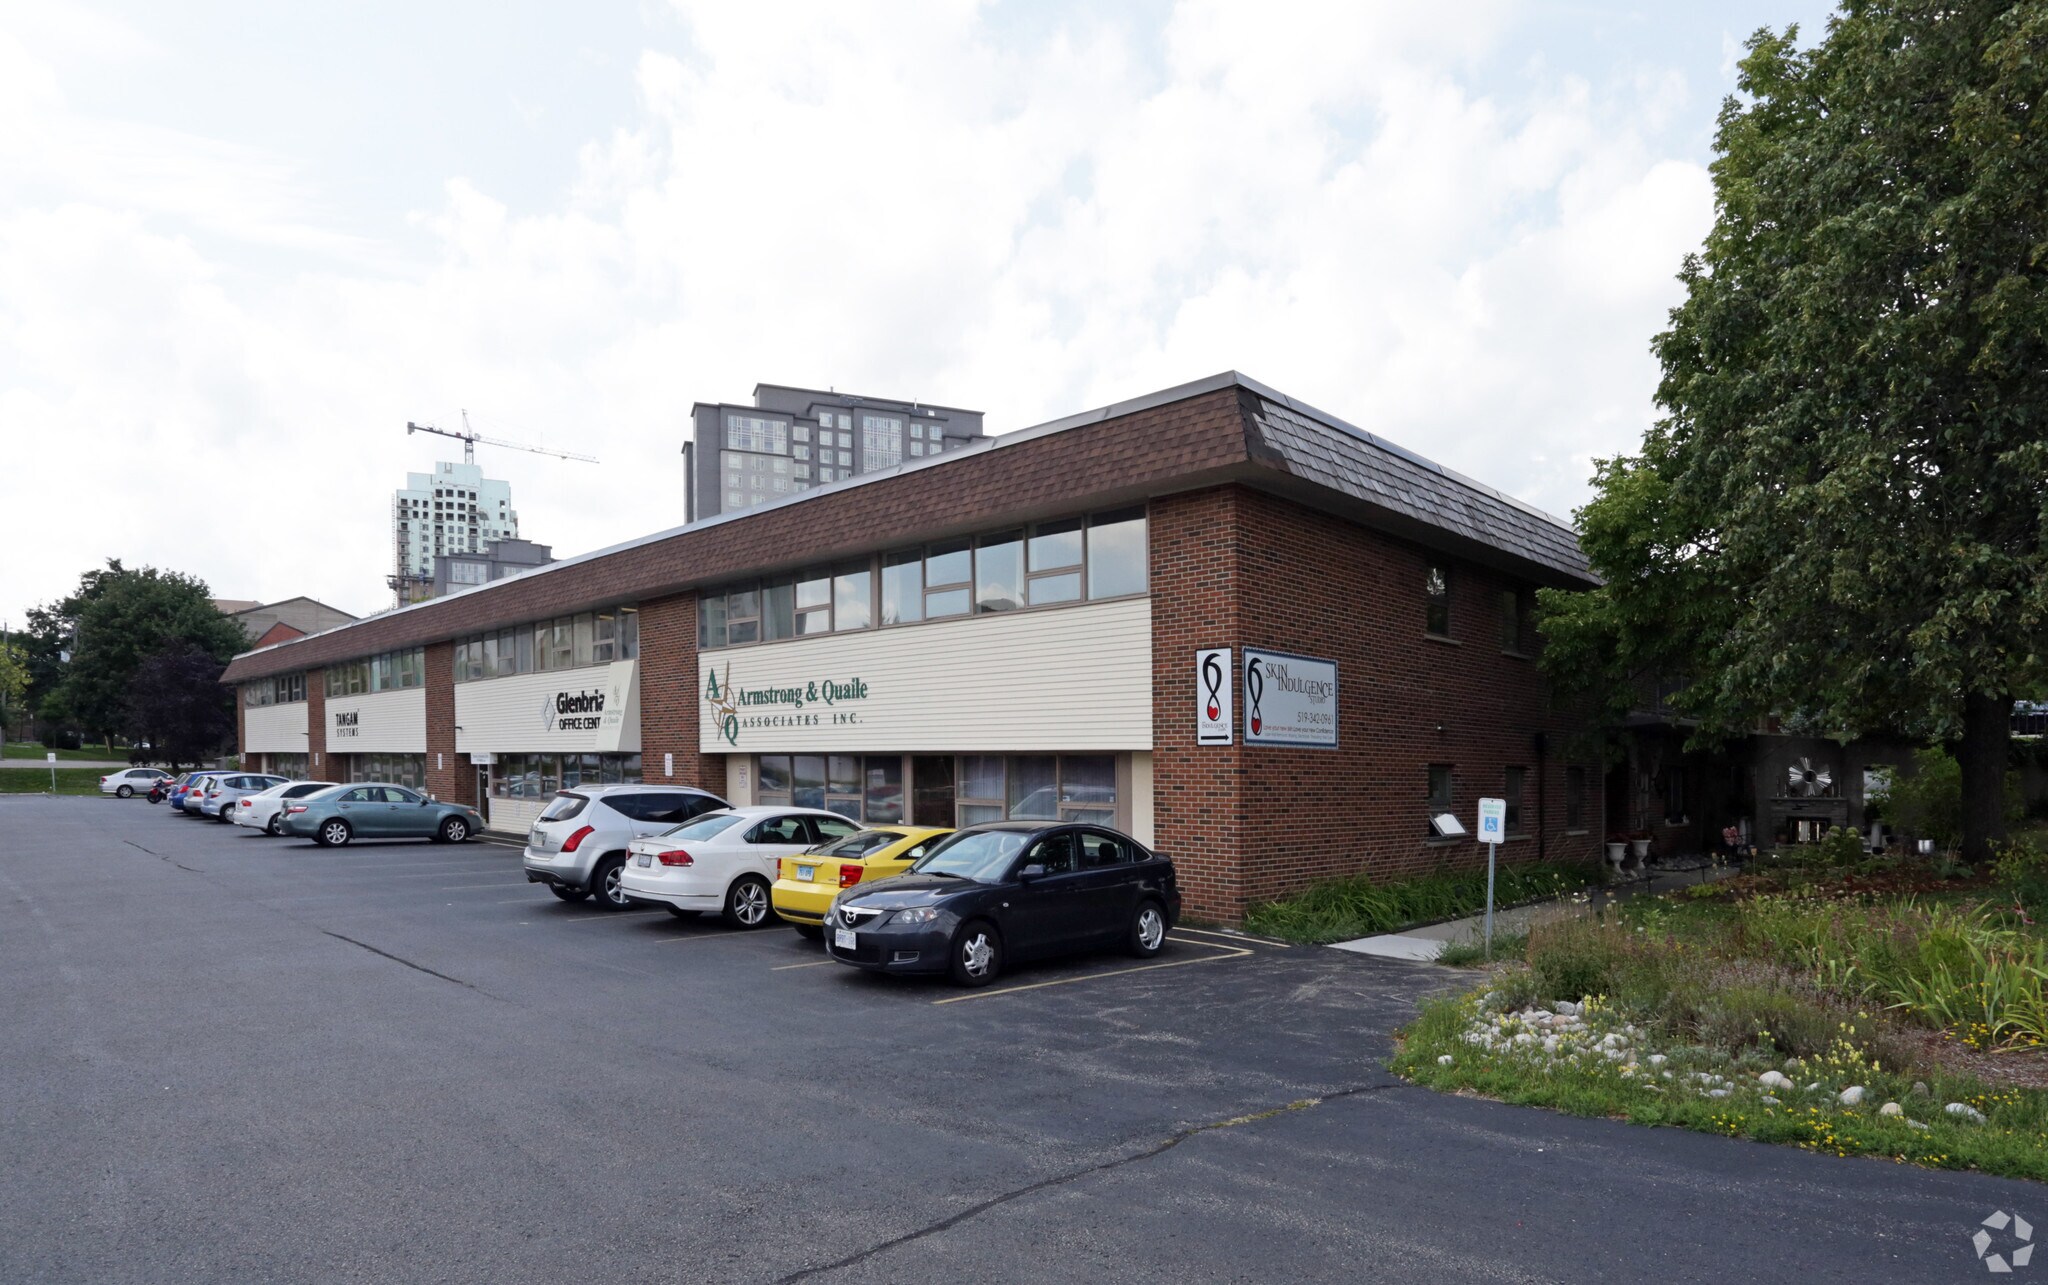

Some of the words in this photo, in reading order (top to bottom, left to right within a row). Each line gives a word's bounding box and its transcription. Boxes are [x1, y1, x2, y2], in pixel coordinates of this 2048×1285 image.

[1265, 662, 1288, 680] SKIN
[737, 686, 803, 709] Armstrong
[805, 681, 818, 702] &
[822, 677, 868, 705] Quaile
[1277, 676, 1333, 699] INDULGENCE
[336, 711, 358, 727] TANGAM
[559, 718, 582, 730] OFFICE
[742, 714, 819, 728] ASSOCIATES
[833, 712, 863, 725] INC.
[337, 727, 359, 737] SYSTEMS
